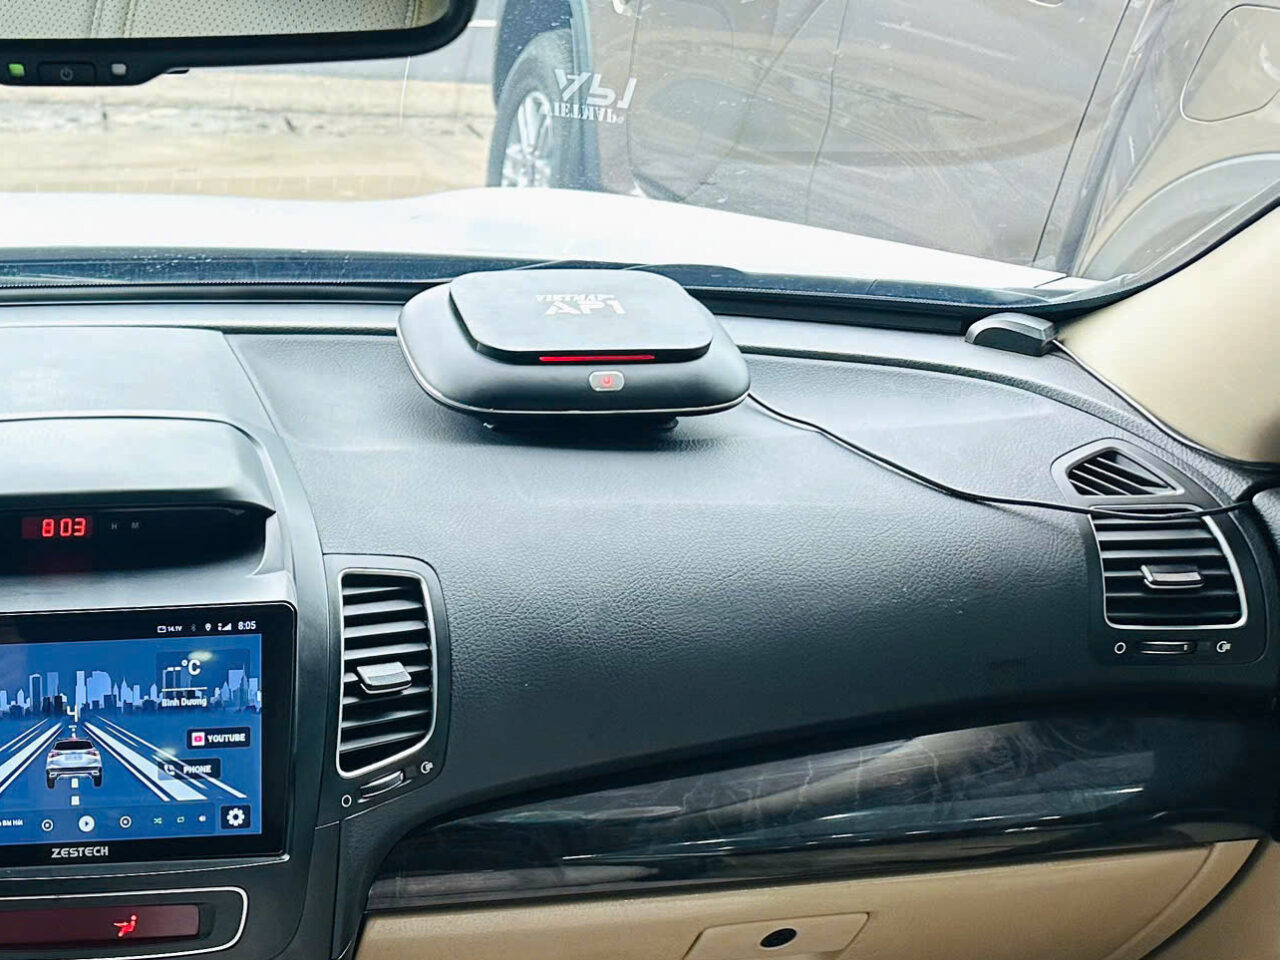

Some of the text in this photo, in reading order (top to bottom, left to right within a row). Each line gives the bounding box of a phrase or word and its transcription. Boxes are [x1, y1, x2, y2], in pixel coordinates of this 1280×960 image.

[546, 300, 627, 315] AP1
[237, 621, 257, 631] 8:05
[207, 733, 246, 742] YOUTUBE
[183, 764, 211, 774] PHONE
[51, 846, 109, 859] ZESTECH
